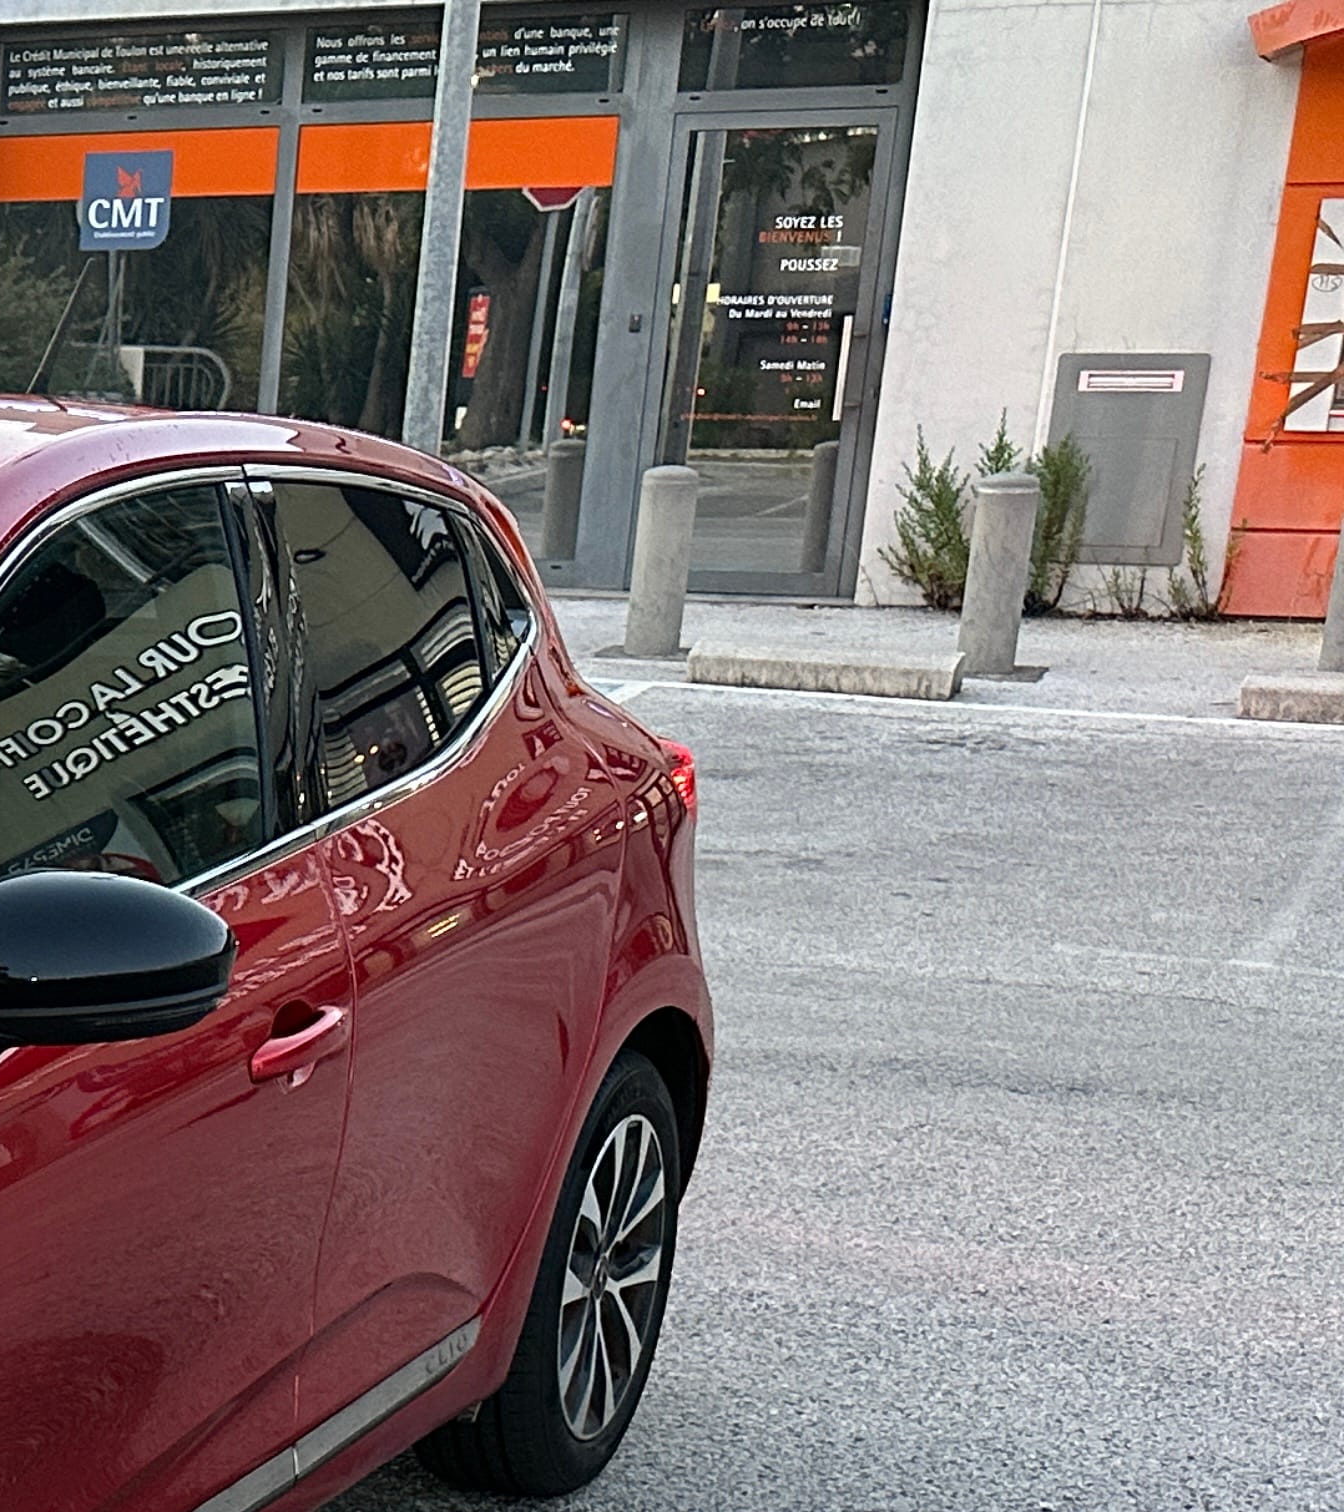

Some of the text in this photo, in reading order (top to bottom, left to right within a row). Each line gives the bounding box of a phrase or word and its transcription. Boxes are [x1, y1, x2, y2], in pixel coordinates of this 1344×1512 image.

[740, 19, 756, 30] on
[758, 16, 807, 32] s'occupe
[316, 36, 343, 49] Nous
[347, 34, 385, 47] offrons
[390, 33, 406, 45] les
[514, 26, 544, 40] d'une
[550, 26, 593, 40] banque,
[599, 26, 620, 37] une
[9, 52, 22, 63] Le
[53, 46, 100, 61] Municipal
[101, 46, 113, 58] de
[115, 44, 147, 57] Toulon
[314, 54, 352, 68] gamme
[355, 52, 369, 63] de
[372, 49, 437, 63] financement
[482, 47, 497, 58] un
[500, 44, 521, 57] lien
[524, 43, 565, 57] humain
[27, 65, 66, 79] système
[193, 56, 267, 71] historiquement
[313, 70, 325, 82] et
[326, 70, 345, 81] nos
[347, 66, 375, 80] tarifs
[376, 67, 400, 79] sont
[400, 65, 432, 80] parmi
[515, 61, 530, 73] du
[532, 60, 576, 73] marché.
[254, 73, 266, 84] et
[47, 97, 58, 109] et
[60, 96, 84, 108] aussi
[178, 90, 214, 104] banque
[216, 91, 229, 102] en
[88, 197, 165, 229] CMT
[775, 215, 844, 229] SOYEZ LES
[758, 230, 833, 244] BIENVENUS
[779, 258, 839, 271] POUSSEZ
[716, 294, 834, 305] HORAIRES D'OUVERTURE
[728, 308, 833, 319] Du Mardi au Vendredi
[760, 359, 826, 370] Samedi Matin
[793, 398, 822, 409] Email
[425, 1332, 468, 1375] CLIO
